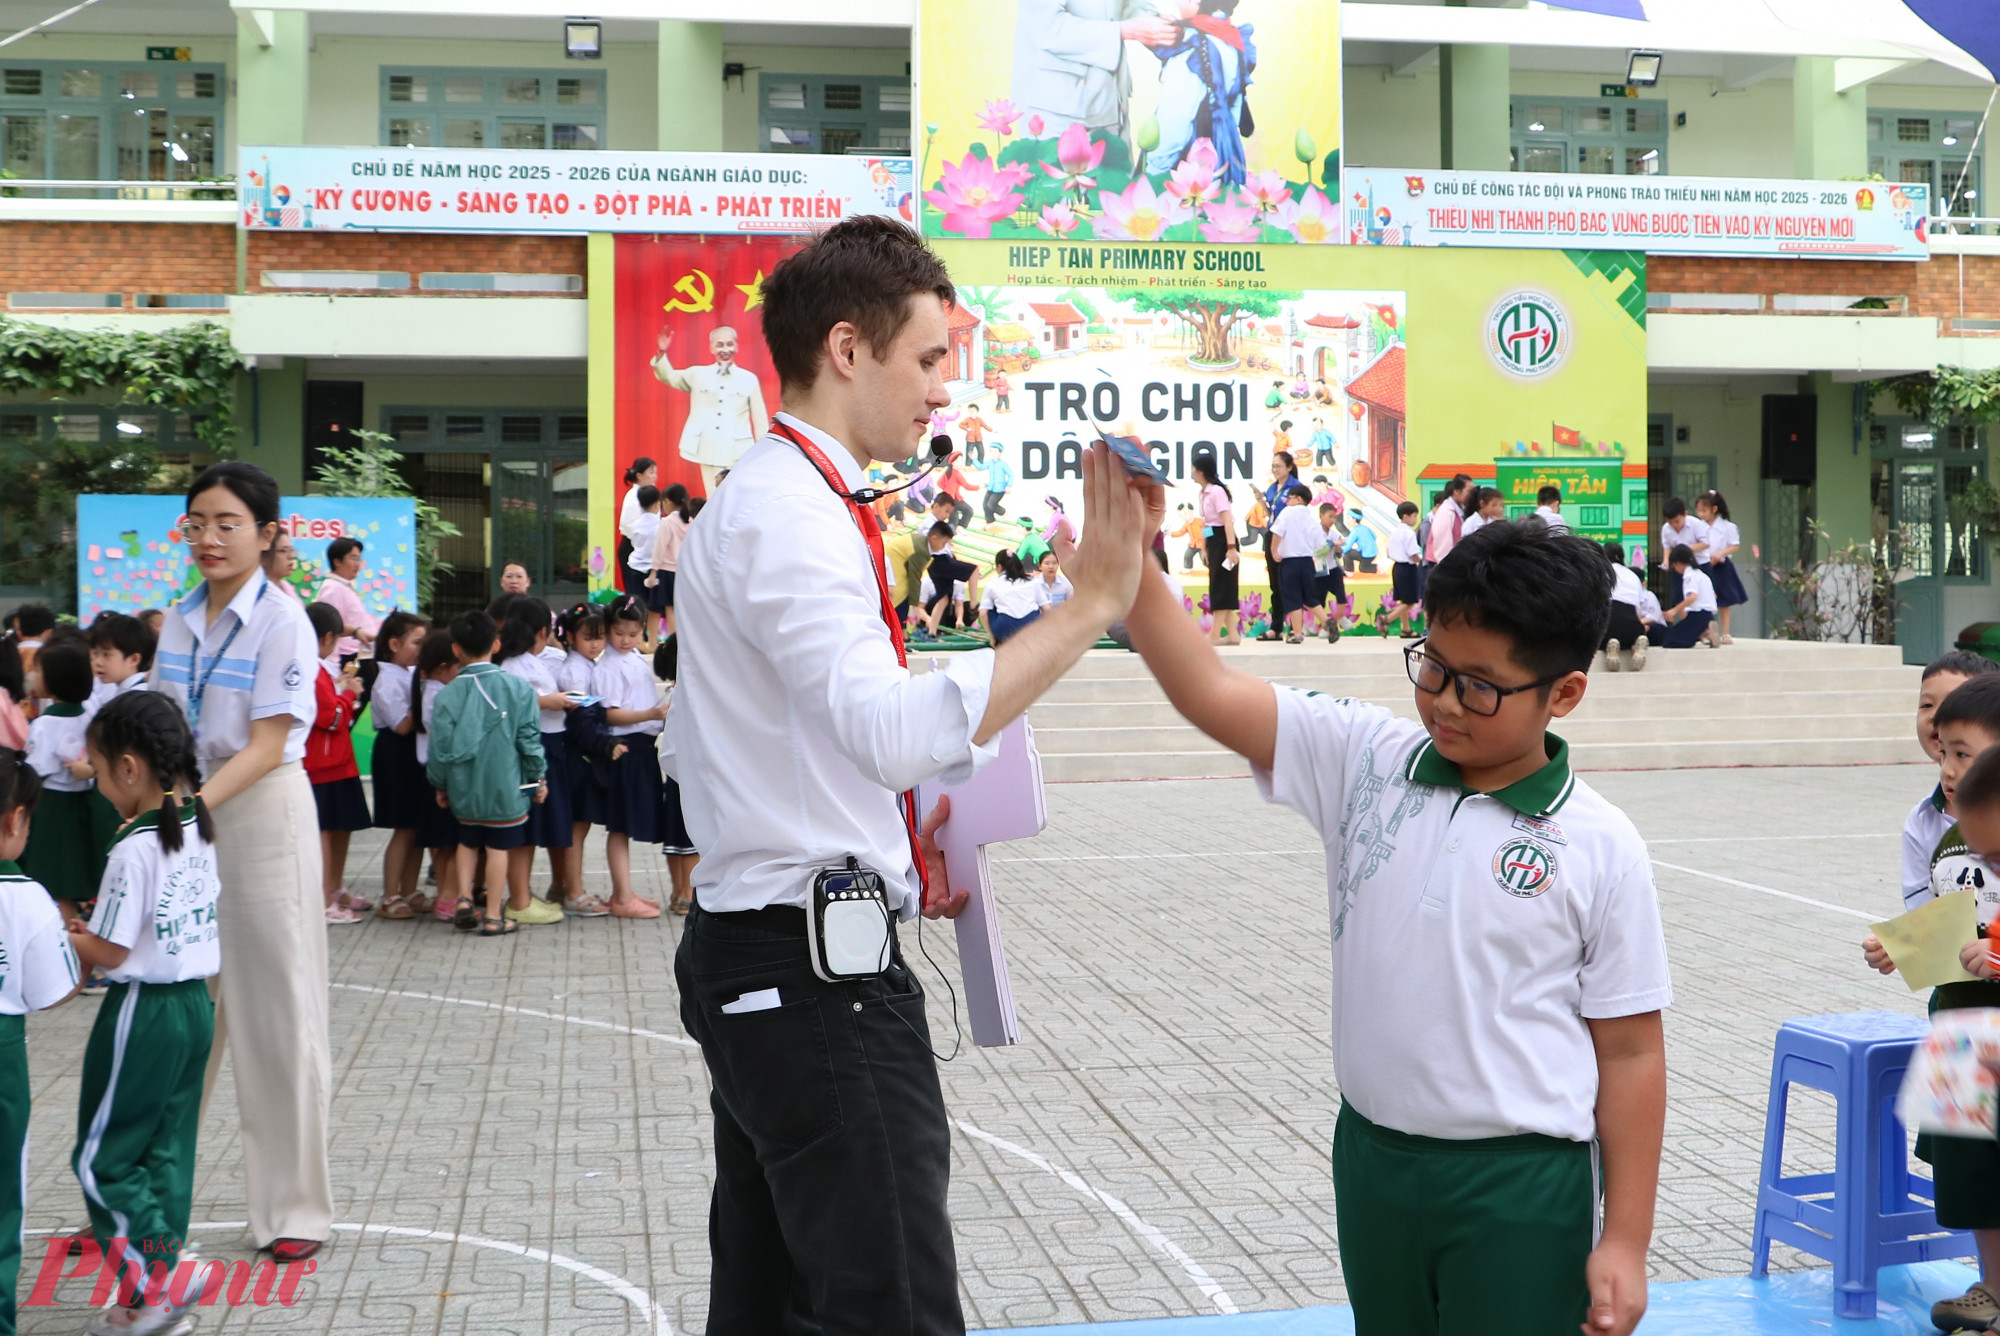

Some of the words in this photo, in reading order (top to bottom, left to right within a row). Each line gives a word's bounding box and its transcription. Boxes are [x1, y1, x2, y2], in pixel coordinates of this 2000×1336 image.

[351, 159, 387, 177] CHỦ
[420, 160, 461, 178] NĂM
[467, 164, 502, 182] HỌC
[508, 165, 550, 180] 2025
[568, 166, 611, 182] 2026
[617, 162, 651, 183] CỦA
[657, 164, 716, 184] NGÀNH
[723, 164, 761, 184] GIÁO
[768, 169, 808, 187] DỤC:
[351, 187, 432, 213] CƯƠNG
[457, 186, 518, 214] SÁNG
[526, 192, 570, 220] TẠO
[594, 188, 639, 221] ĐỘT
[646, 190, 692, 216] PHÁ
[717, 190, 772, 218] PHÁT
[1434, 179, 1459, 196] CHỦ
[1482, 180, 1515, 197] CÔNG
[1519, 181, 1540, 198] TÁC
[1544, 181, 1565, 201] ĐỘI
[1568, 182, 1583, 198] VÀ
[1587, 186, 1627, 200] PHONG
[1631, 184, 1660, 201] TRÀO
[1664, 184, 1697, 202] THIẾU
[1701, 189, 1721, 203] NHI
[1725, 187, 1751, 203] NĂM
[1755, 190, 1778, 206] HỌC
[1782, 192, 1808, 204] 2025
[1820, 193, 1848, 205] 2026
[1471, 208, 1495, 230] NHI
[1008, 246, 1051, 268] HIEP
[1057, 247, 1093, 269] TAN
[1101, 248, 1187, 270] PRIMARY
[1193, 250, 1266, 272] SCHOOL
[1007, 274, 1032, 286] Hợp
[1035, 274, 1054, 285] tác
[1065, 274, 1098, 286] Trách
[1101, 274, 1138, 287] nhiệm
[1149, 275, 1175, 287] Phát
[1179, 275, 1207, 288] triển
[1216, 276, 1245, 290] Sáng
[1248, 278, 1267, 290] tạo
[1024, 367, 1120, 422] TRÒ
[1141, 379, 1248, 422] CHƠI
[1022, 431, 1101, 480] DÂ
[1567, 474, 1608, 495] TÂN
